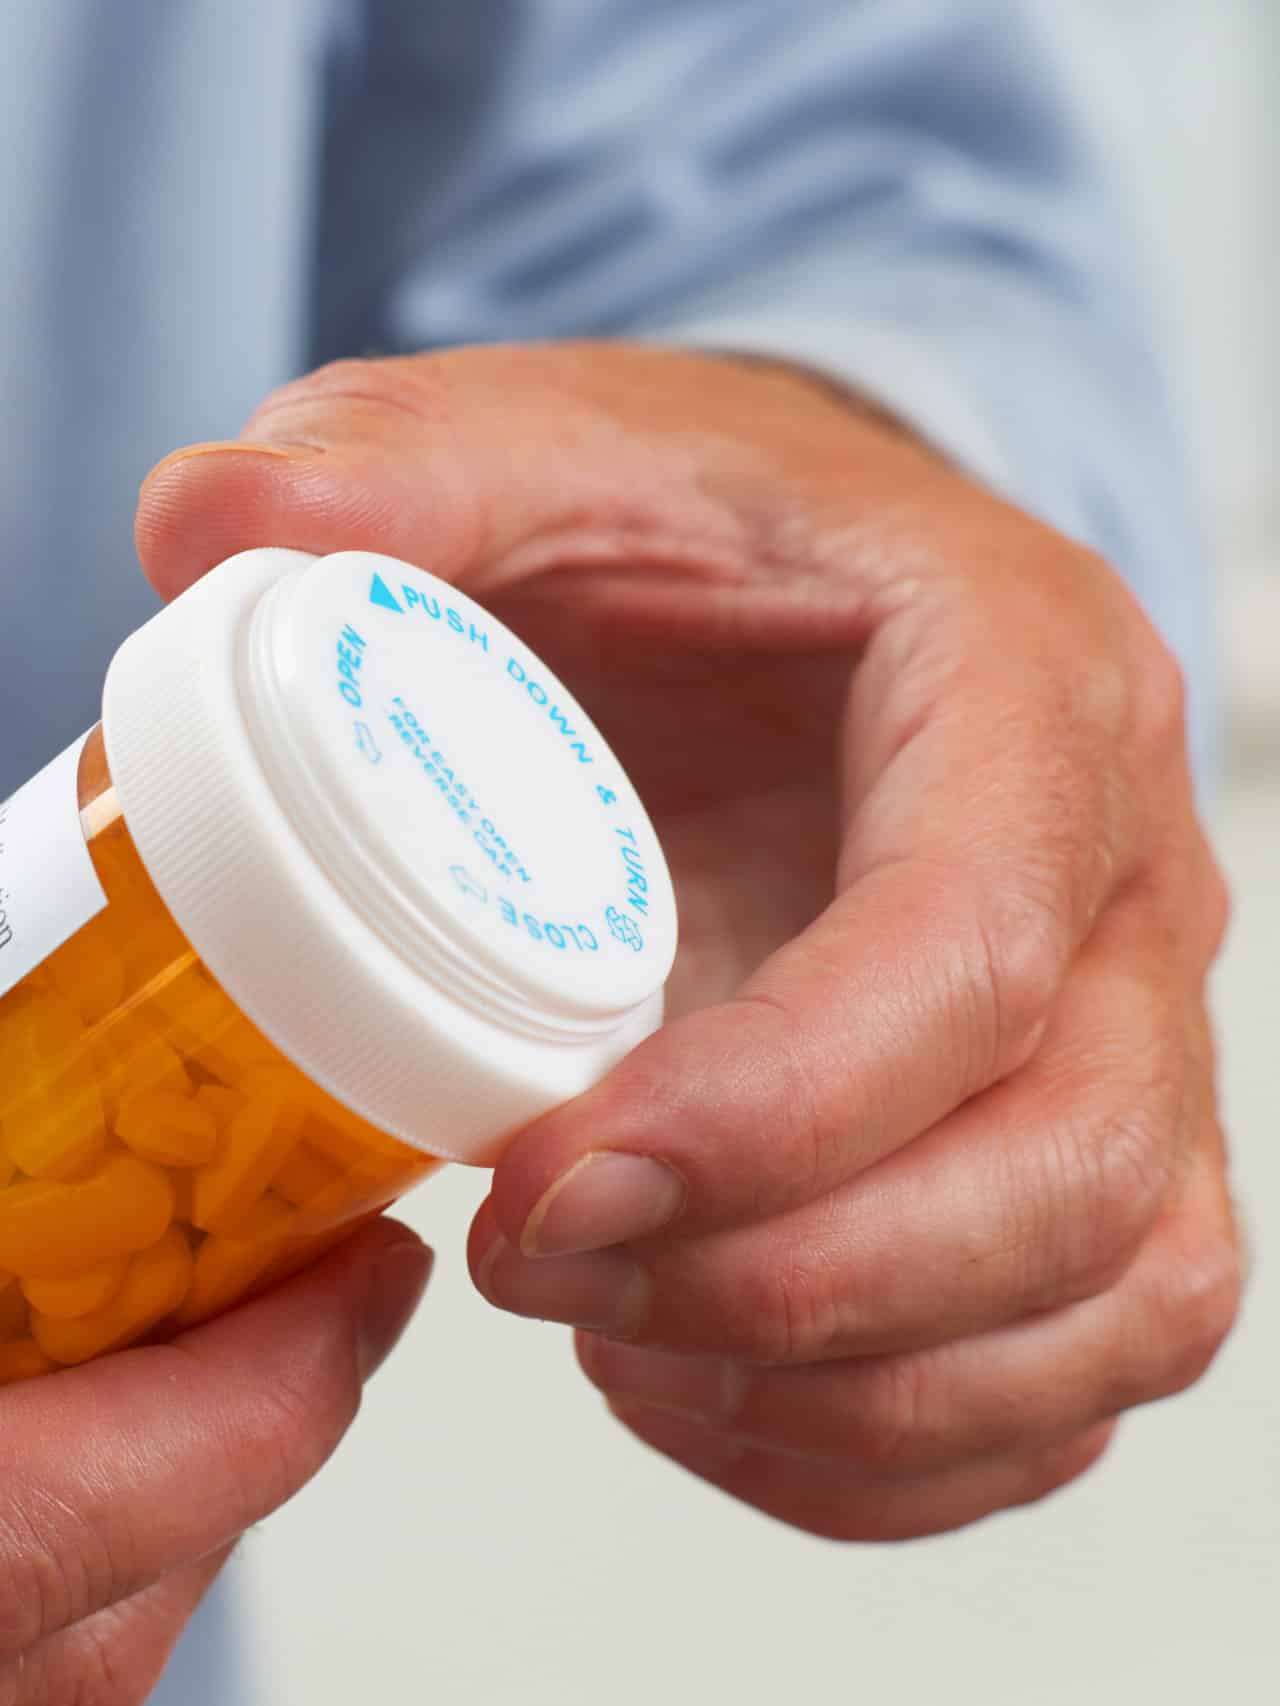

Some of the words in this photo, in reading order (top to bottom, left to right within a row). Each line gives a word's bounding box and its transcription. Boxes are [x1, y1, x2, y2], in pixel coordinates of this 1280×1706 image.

[336, 623, 367, 708] OPEN
[389, 713, 471, 824] REVERSE
[473, 830, 514, 876] CAP
[392, 696, 431, 744] FOR
[431, 750, 480, 810] EASY
[480, 817, 532, 883] OPEN
[401, 583, 488, 652] PUSH
[506, 657, 594, 764] DOWN
[596, 784, 617, 805] &
[615, 826, 649, 918] TURN
[497, 894, 599, 951] CLOSE
